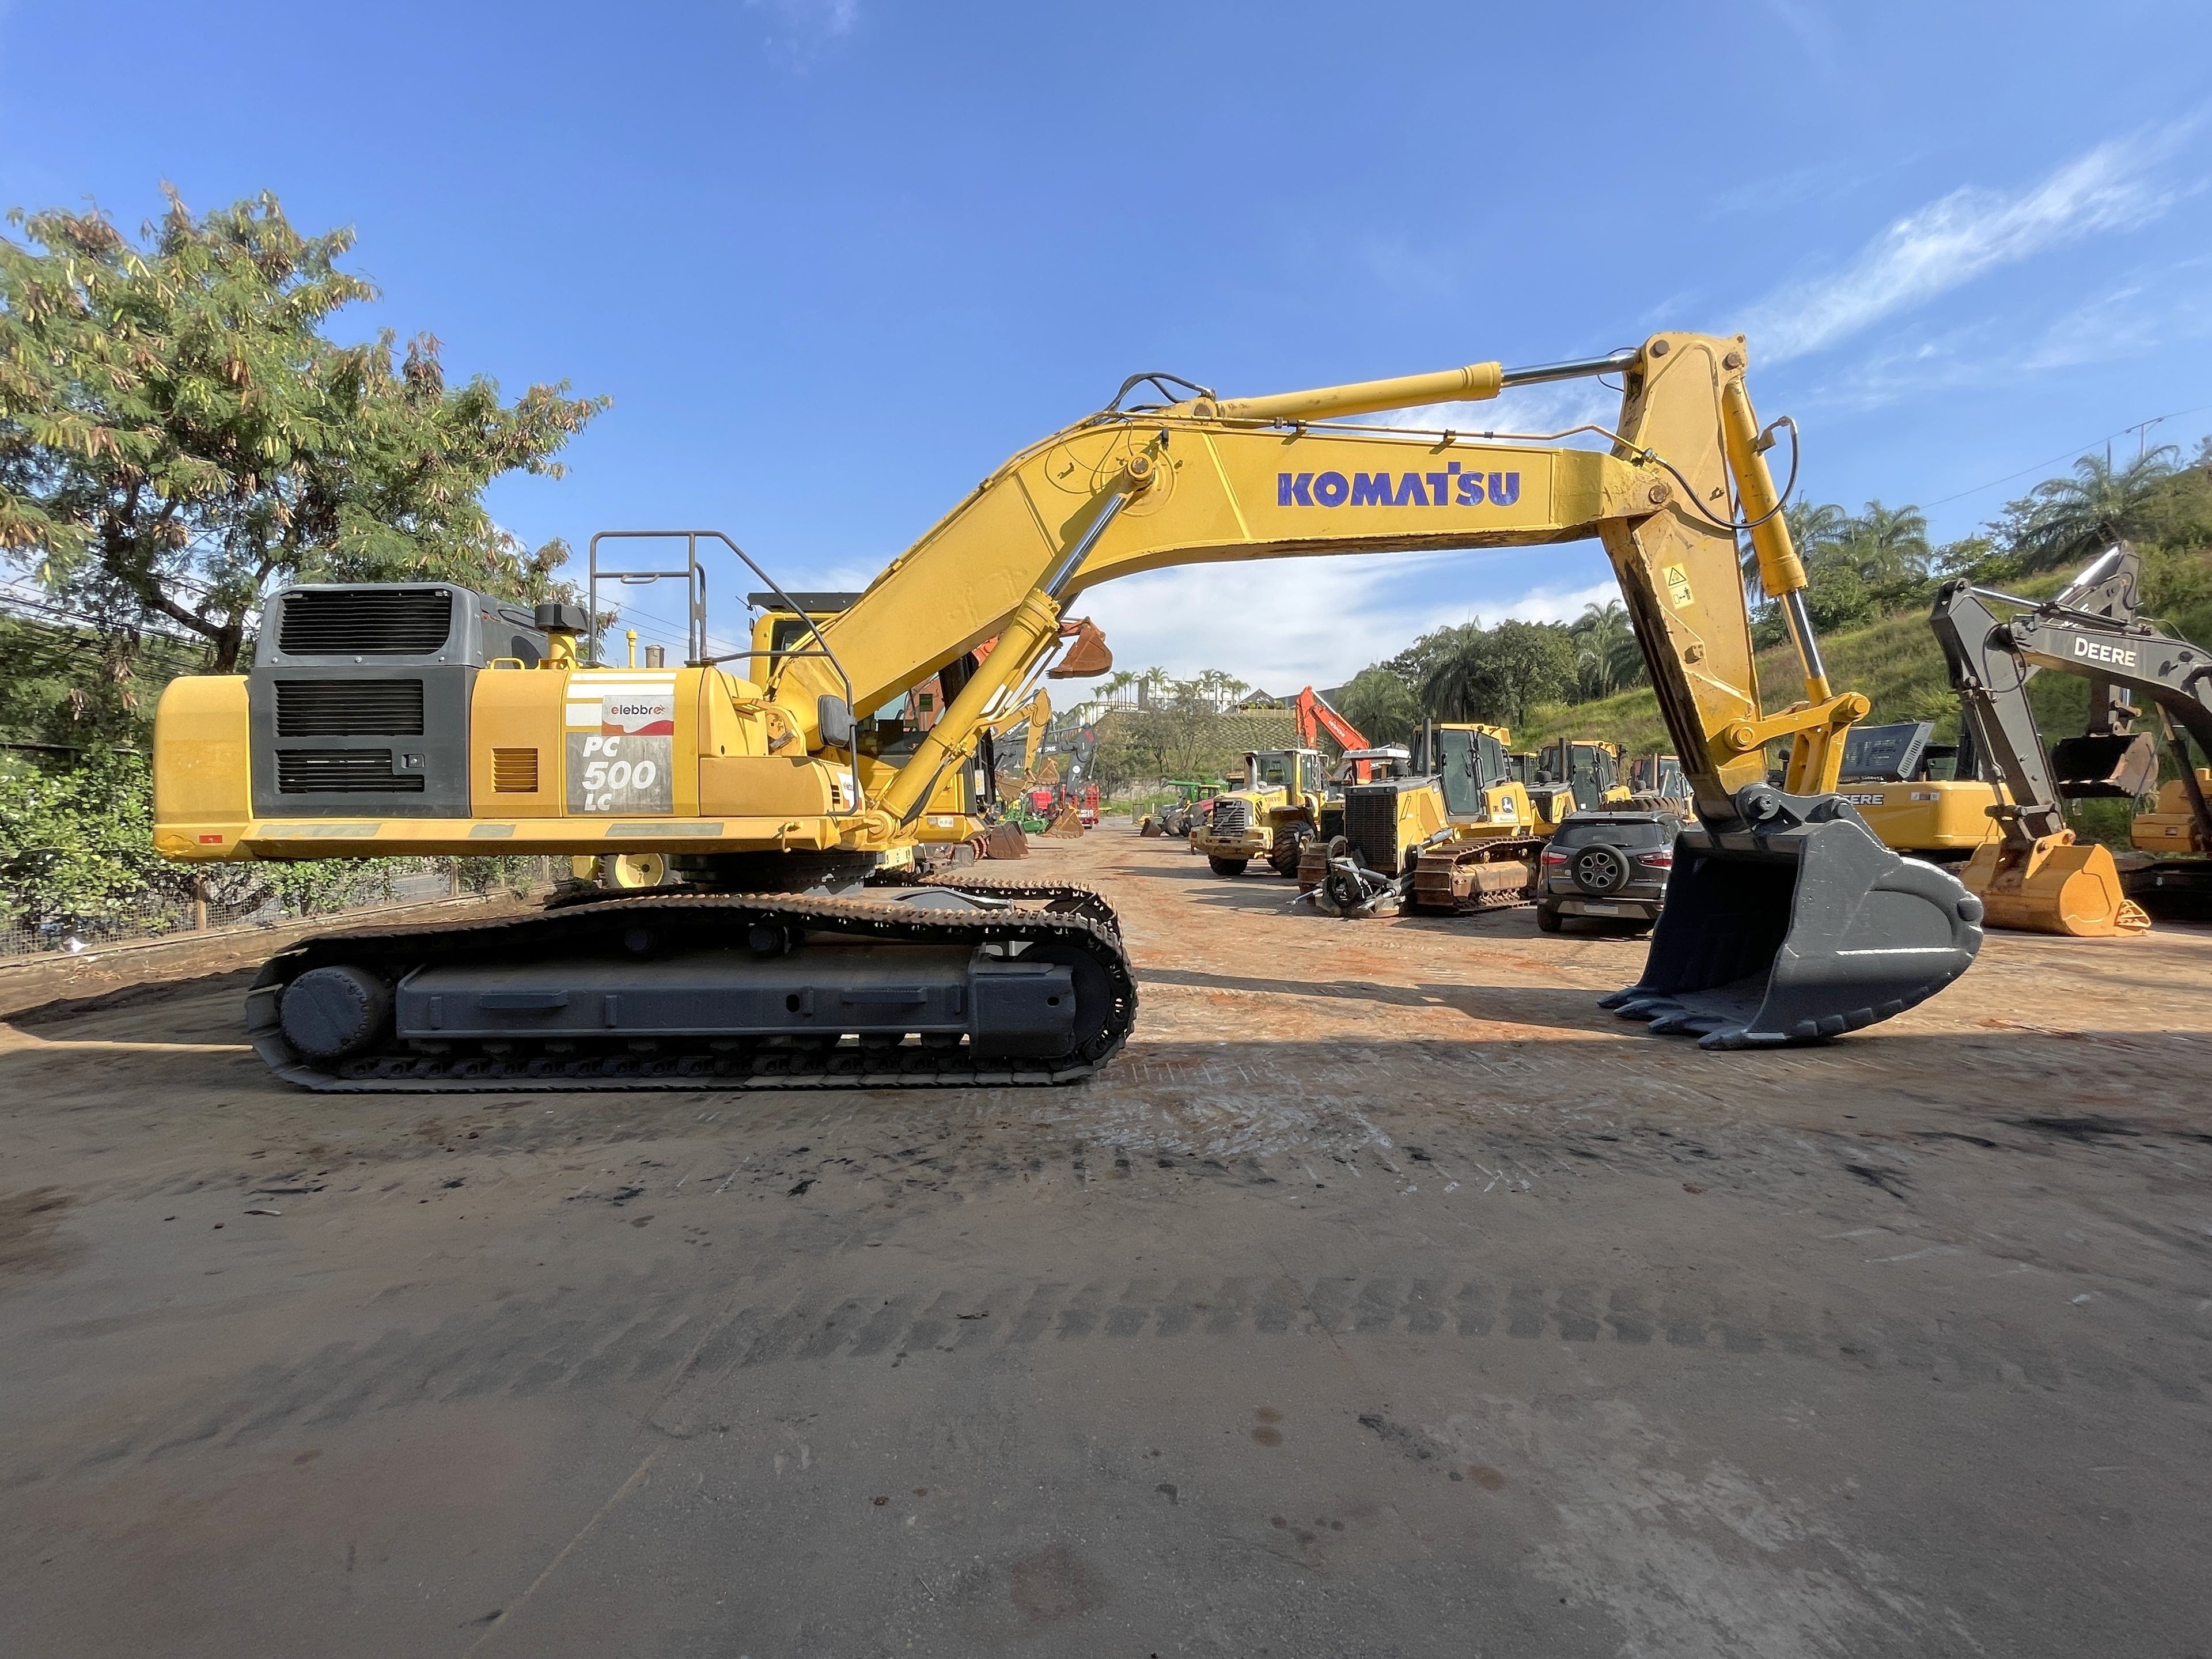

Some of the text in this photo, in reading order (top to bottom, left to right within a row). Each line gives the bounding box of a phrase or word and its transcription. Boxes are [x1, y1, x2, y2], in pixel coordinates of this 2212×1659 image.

[1277, 461, 1521, 507] KOMATSU
[2074, 637, 2137, 668] DEERE
[582, 736, 620, 757] PC
[582, 760, 656, 790] 500
[584, 793, 612, 811] LC
